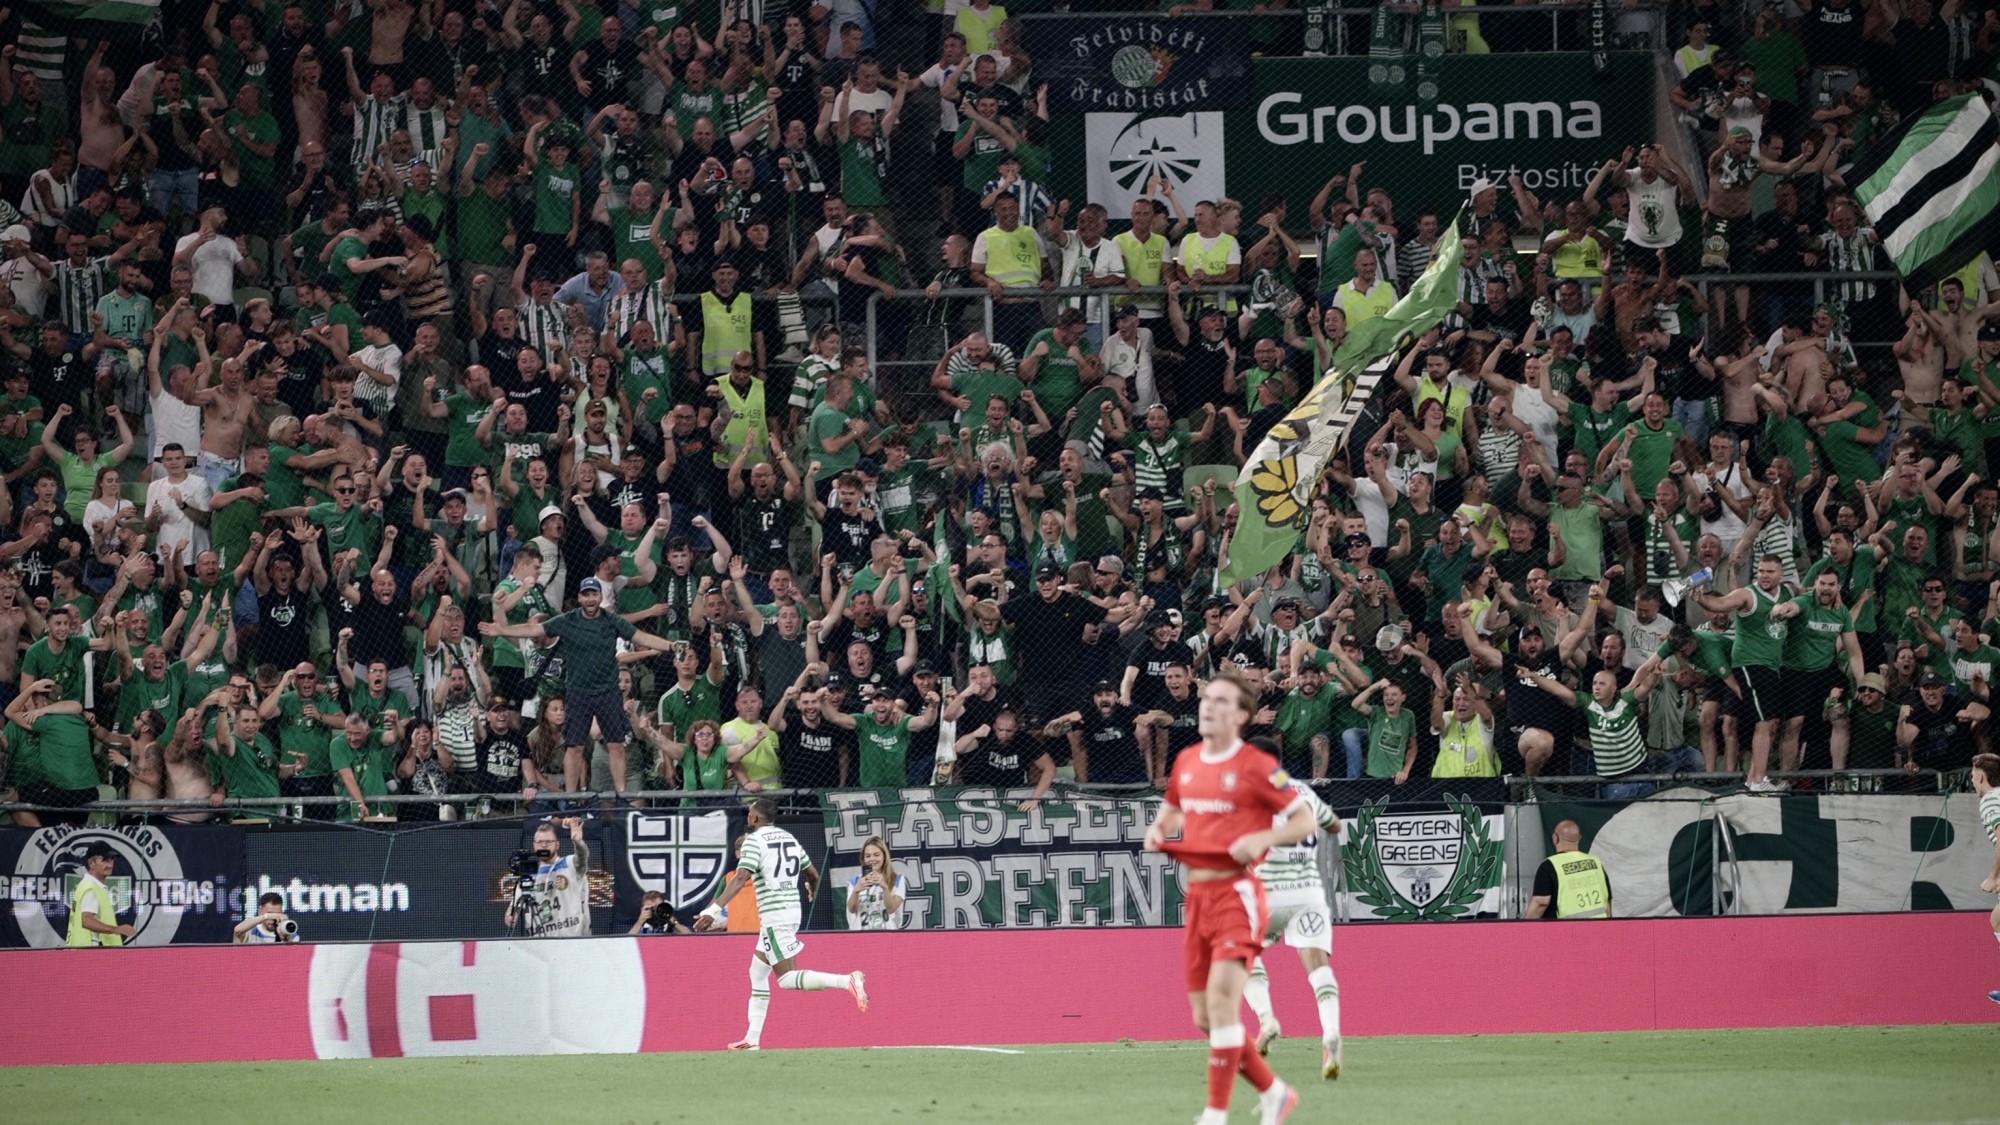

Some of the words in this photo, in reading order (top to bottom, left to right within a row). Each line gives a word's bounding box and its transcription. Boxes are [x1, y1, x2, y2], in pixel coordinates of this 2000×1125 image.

[1257, 92, 1601, 155] Groupama
[1210, 260, 1225, 271] 432
[1378, 819, 1461, 836] EASTERN
[767, 842, 800, 878] 75
[1381, 843, 1458, 861] GREENS
[0, 875, 61, 900] GREEN
[135, 878, 214, 905] ULTRAS
[888, 850, 1189, 930] GREEN
[1577, 890, 1601, 908] 312
